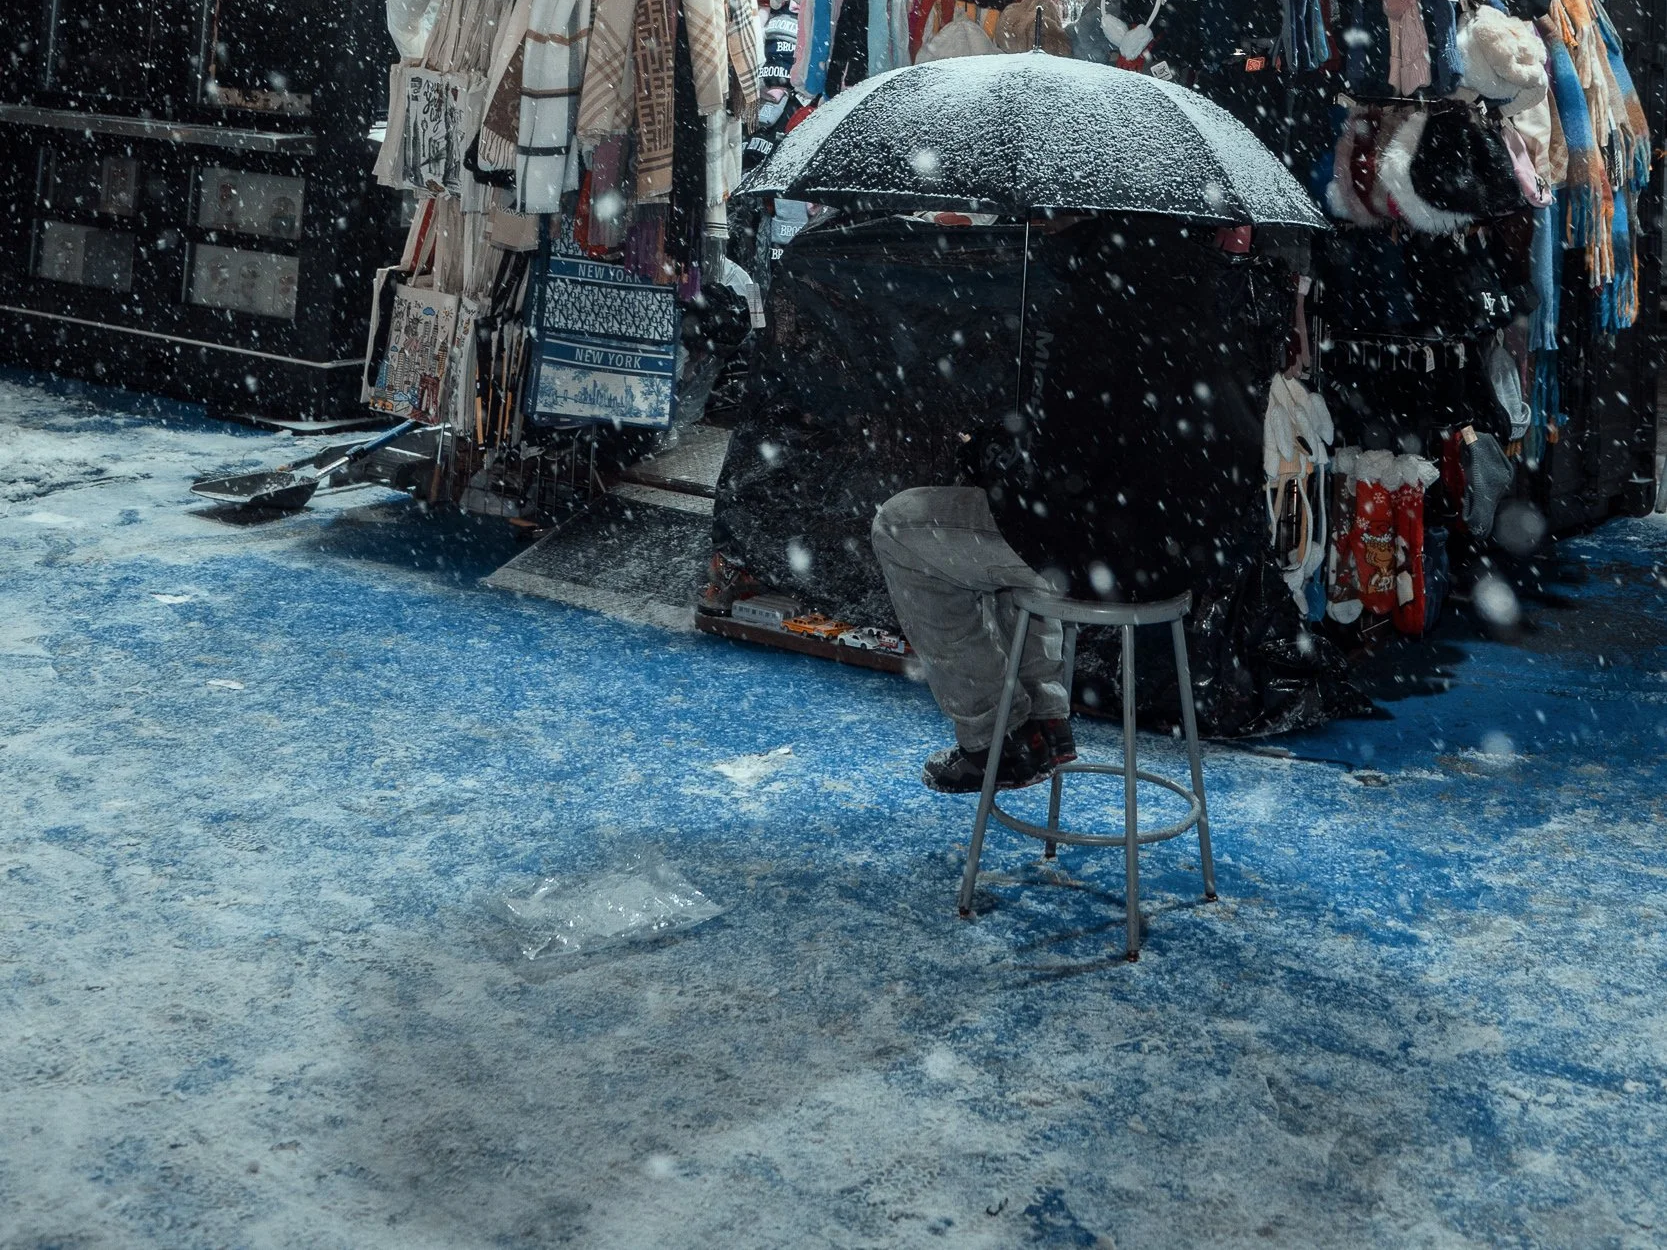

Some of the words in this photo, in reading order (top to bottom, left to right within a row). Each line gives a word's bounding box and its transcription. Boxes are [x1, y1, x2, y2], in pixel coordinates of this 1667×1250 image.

[577, 263, 604, 280] NEW
[575, 348, 603, 365] NEW
[607, 353, 642, 370] YORK
